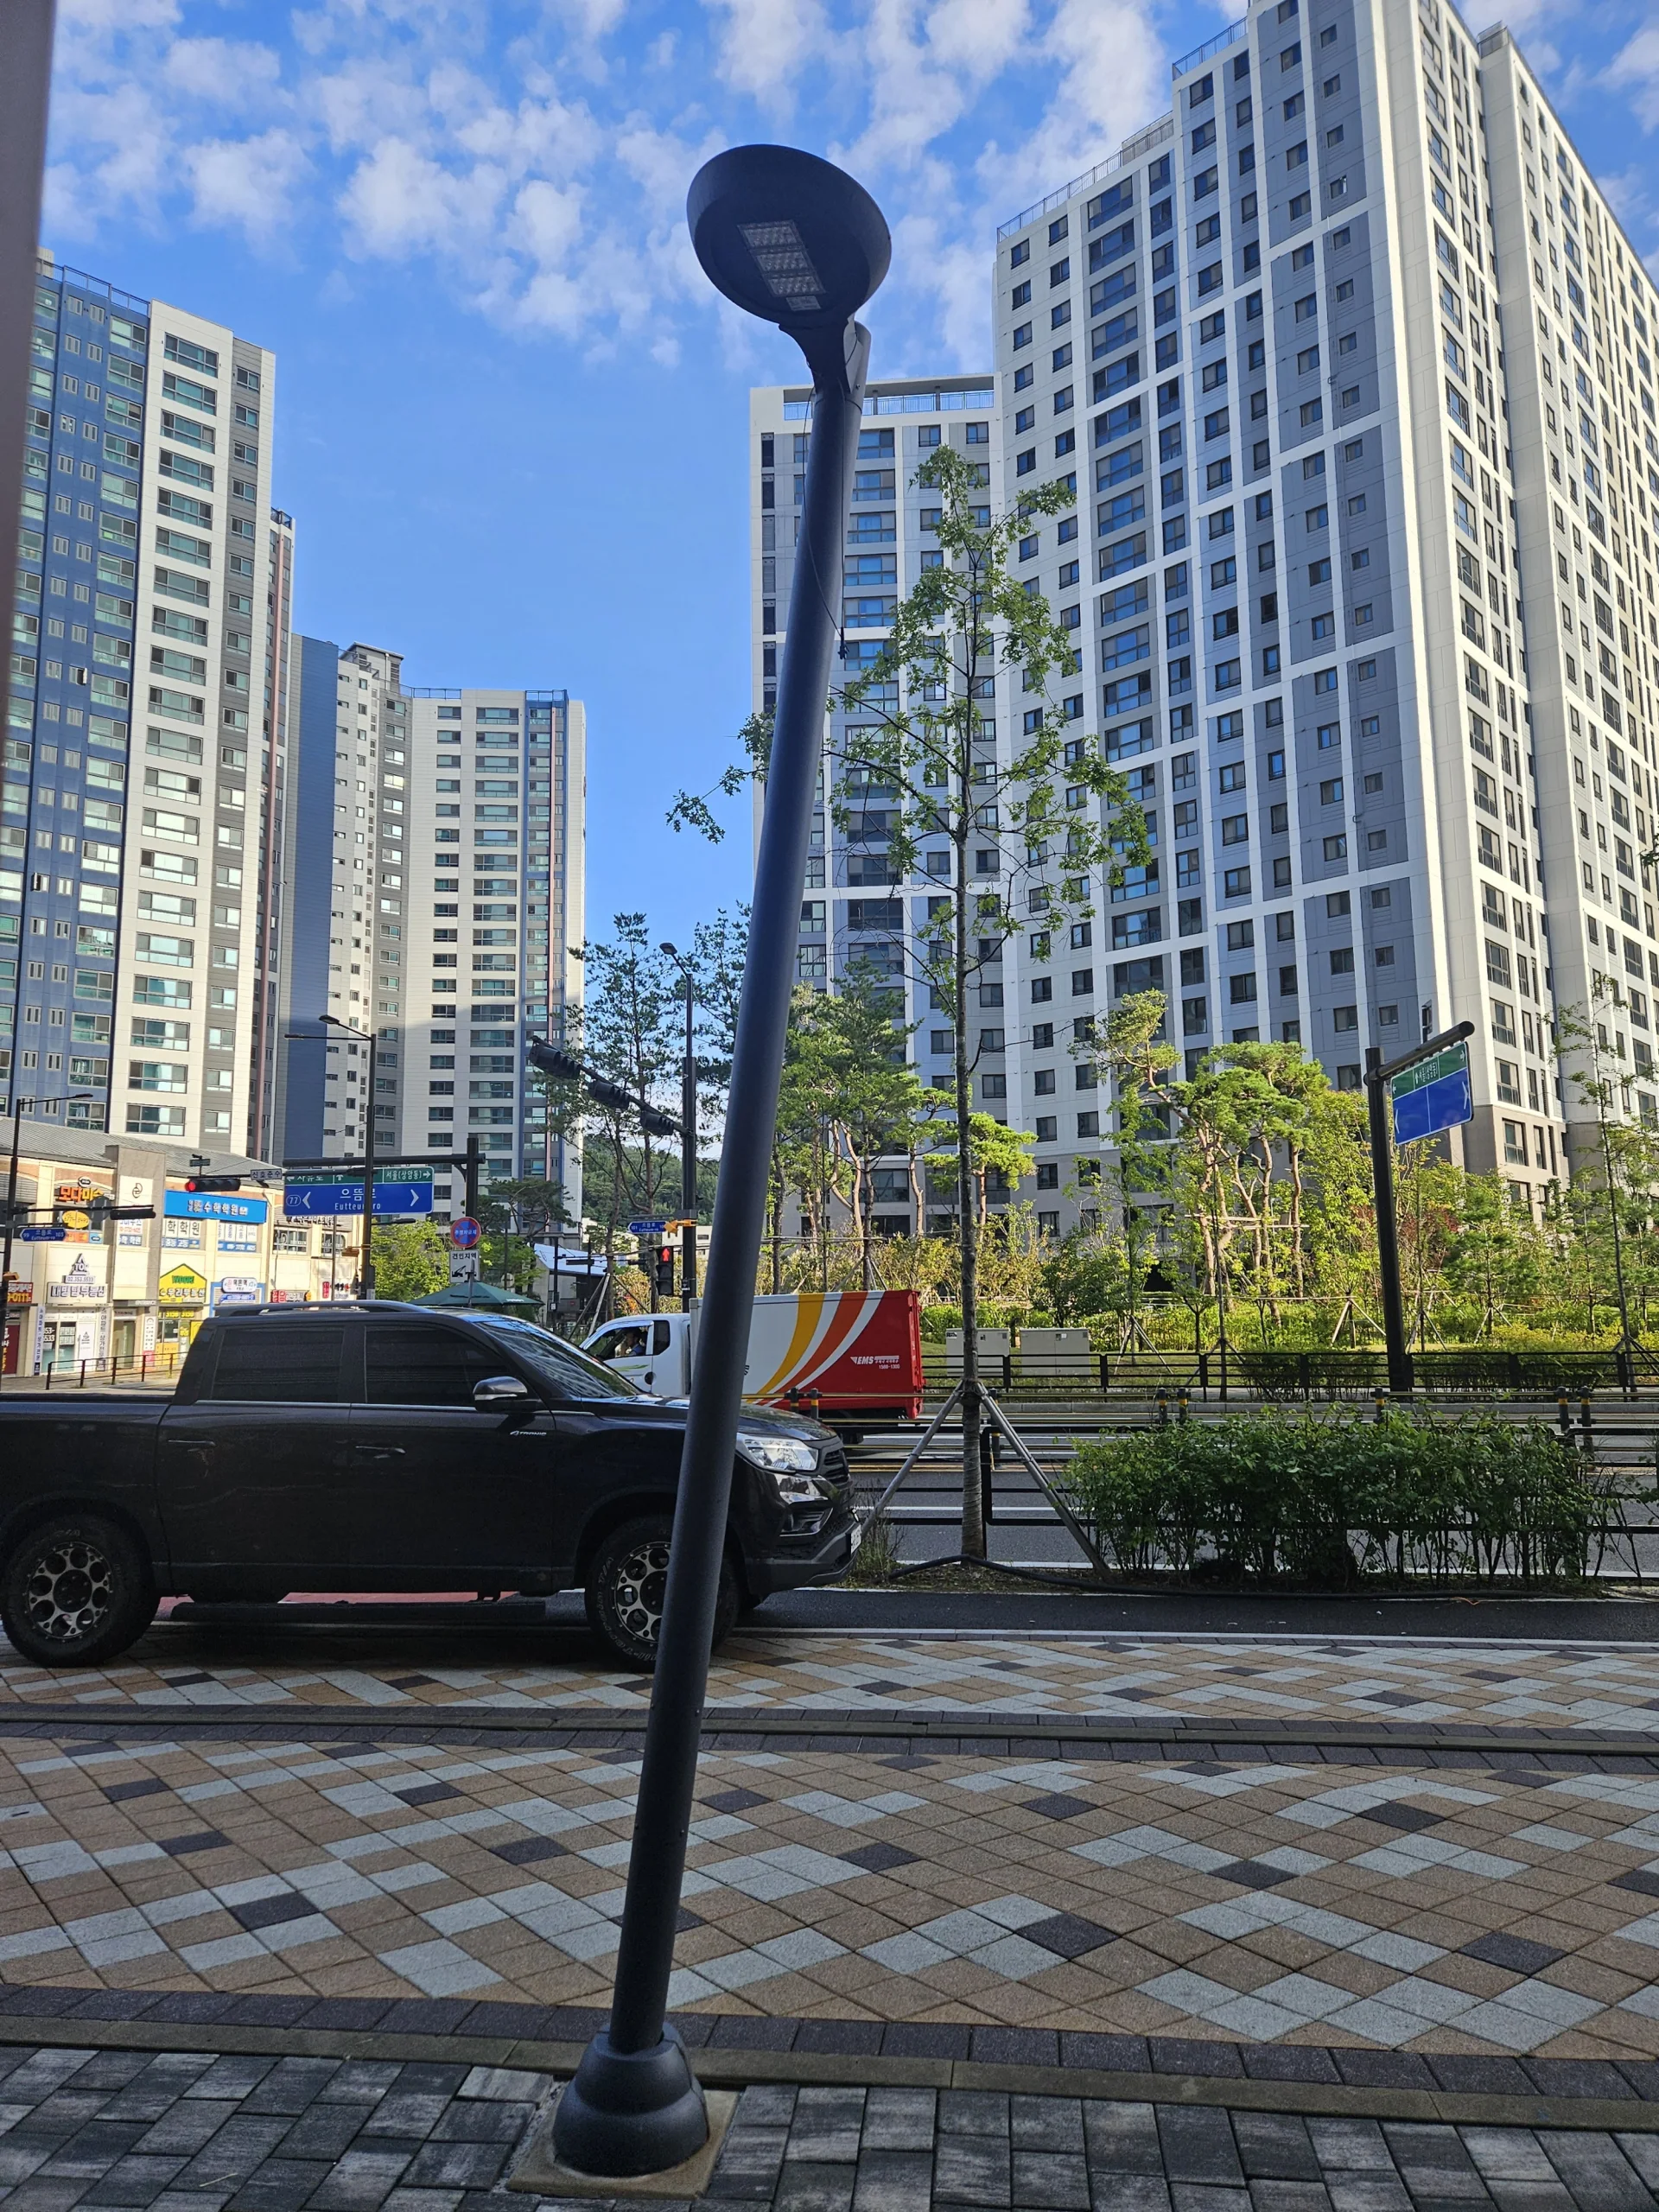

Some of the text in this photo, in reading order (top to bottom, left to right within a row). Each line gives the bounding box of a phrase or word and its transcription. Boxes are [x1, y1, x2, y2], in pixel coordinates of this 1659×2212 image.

[252, 1170, 281, 1179] 신호준수
[385, 1169, 422, 1180] 서울(상암동)
[334, 1202, 381, 1211] Eutteuro
[857, 1356, 874, 1364] EMS
